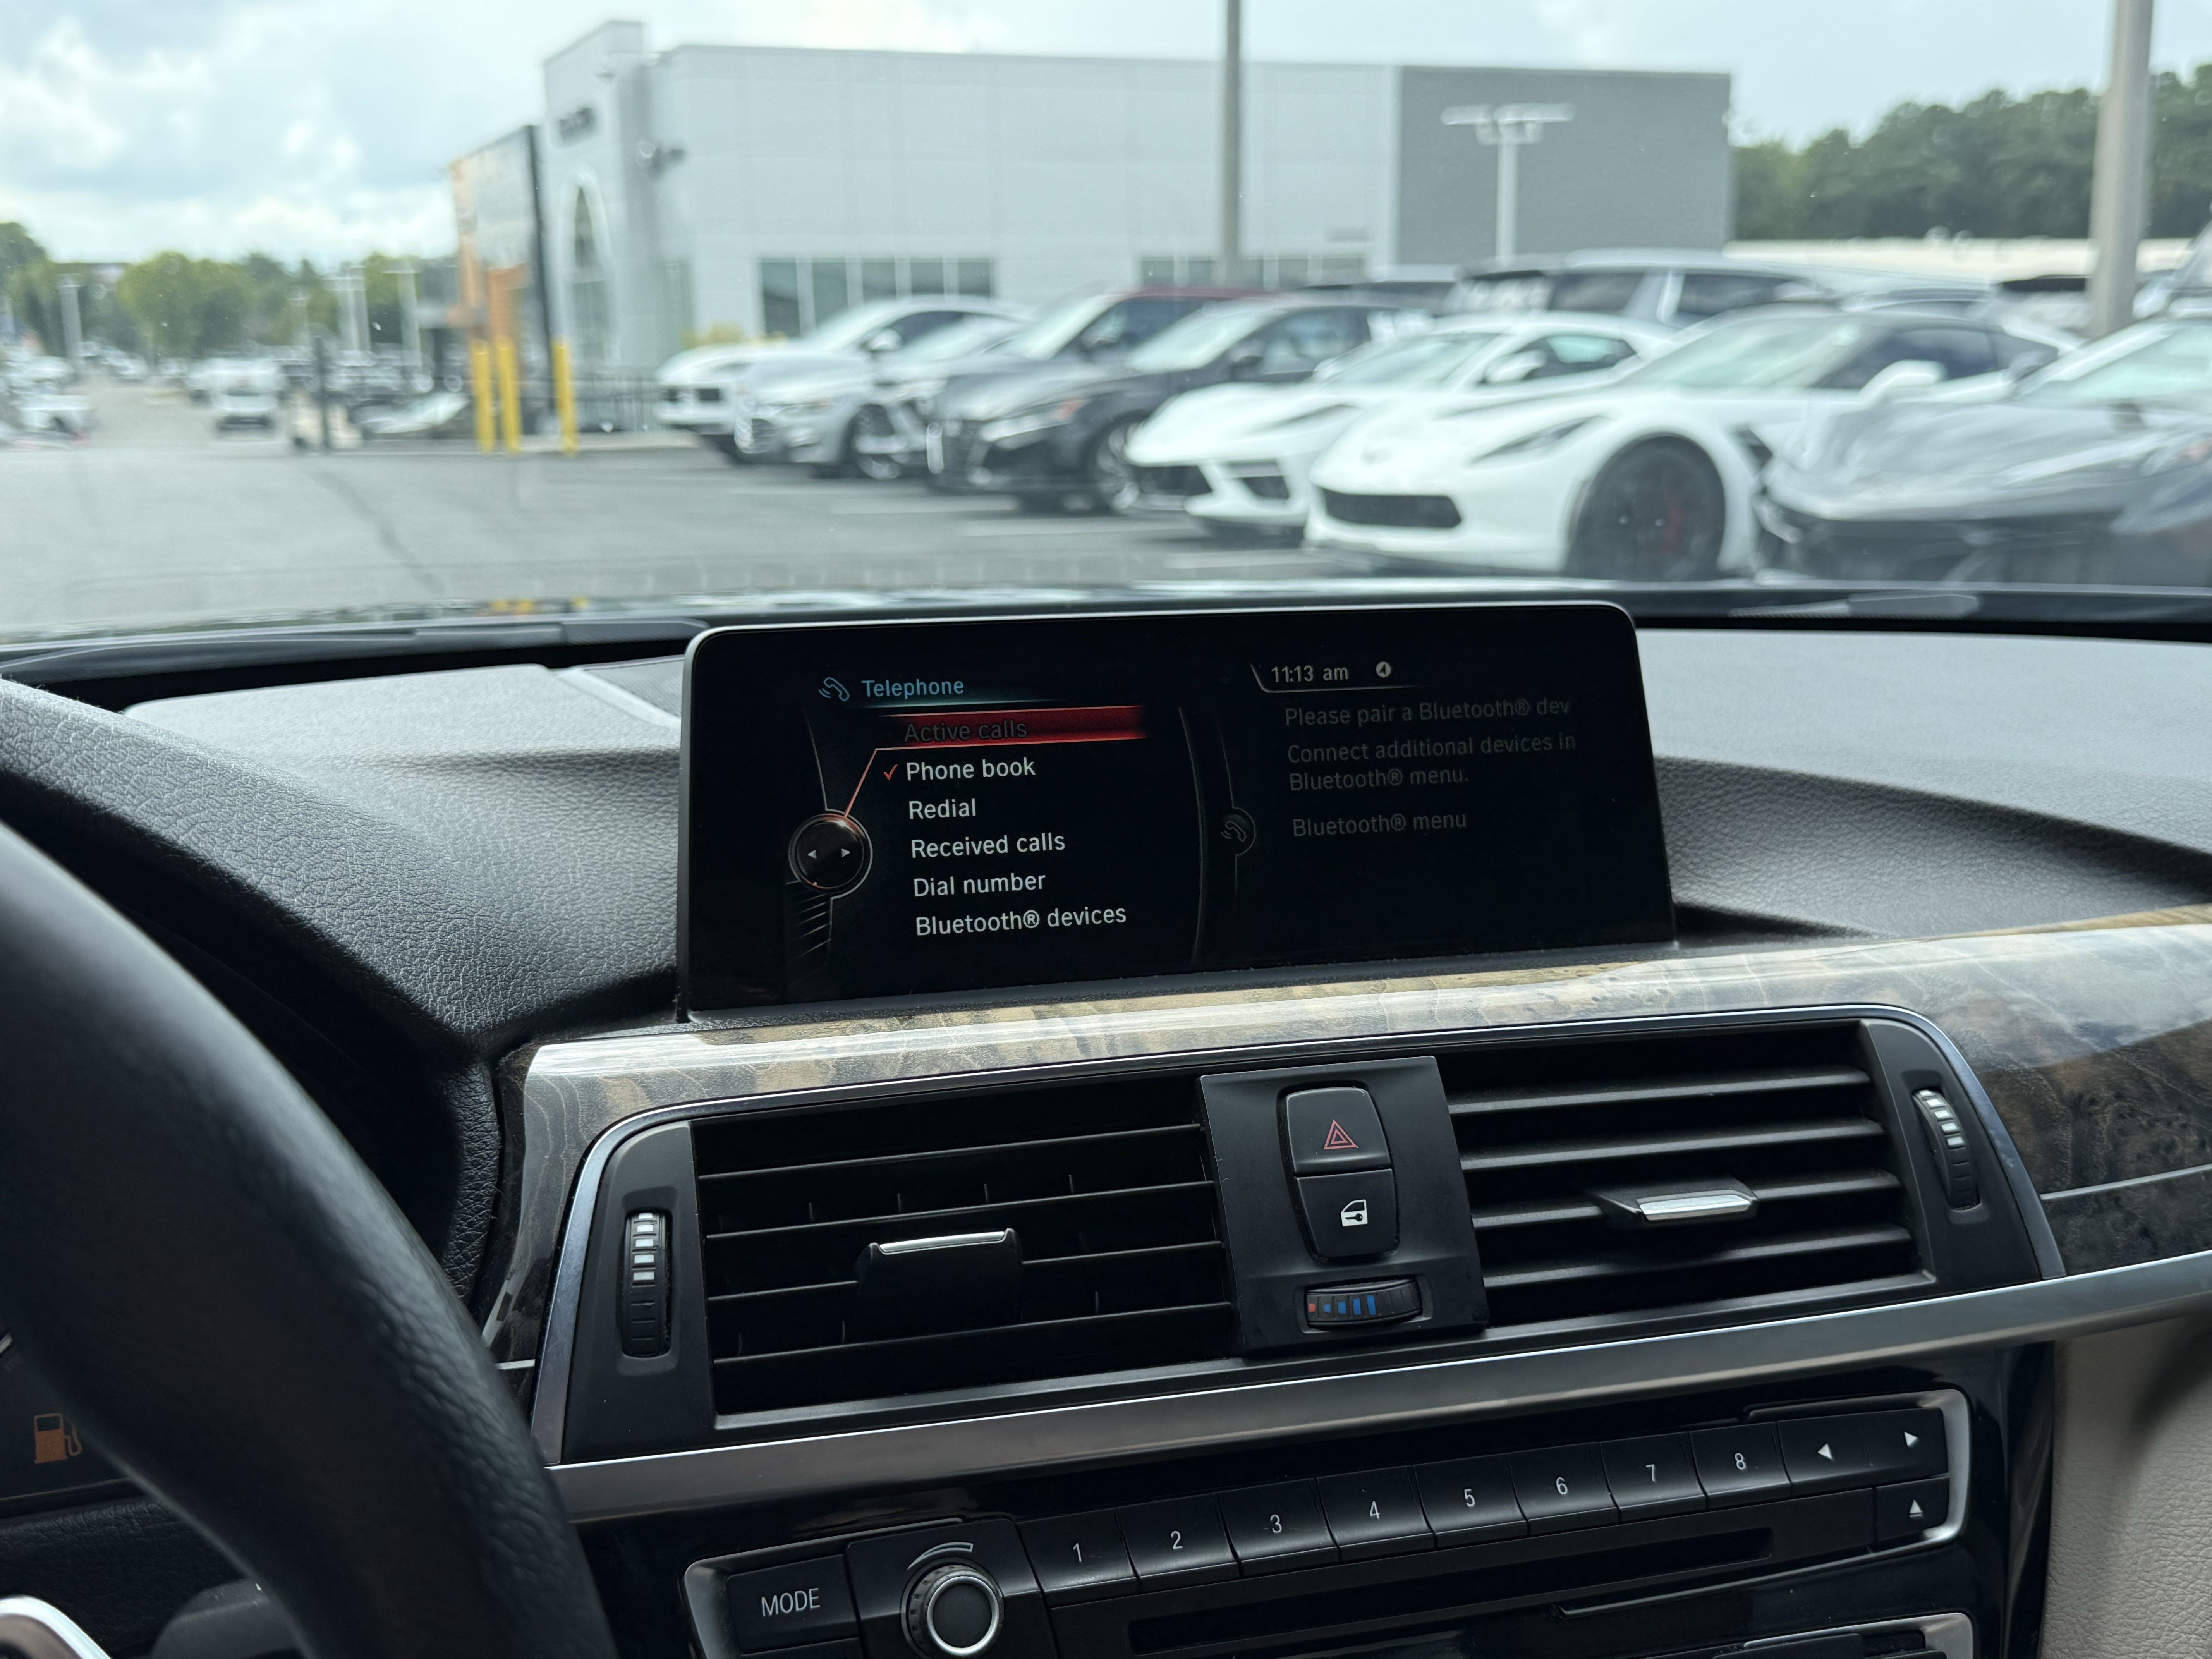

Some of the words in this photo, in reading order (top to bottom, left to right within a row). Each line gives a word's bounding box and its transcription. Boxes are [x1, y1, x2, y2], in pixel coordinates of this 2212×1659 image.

[1271, 665, 1314, 683] 11:13
[1322, 667, 1349, 681] am
[861, 678, 964, 700] Telephone
[1285, 708, 1350, 726] Please
[1357, 704, 1395, 728] pair
[1401, 706, 1412, 722] a
[1419, 697, 1531, 720] Bluetooth®
[1536, 697, 1570, 715] dev
[905, 721, 970, 742] Active
[977, 720, 1028, 740] calls
[1287, 743, 1369, 763] Connect
[1375, 736, 1473, 759] additional
[1480, 734, 1553, 754] devices
[1558, 732, 1576, 750] in
[906, 761, 975, 781] Phone
[982, 757, 1036, 778] book
[1289, 768, 1403, 792] Bluetooth®
[1410, 769, 1469, 785] menu.
[908, 797, 976, 820] Redial
[1292, 813, 1407, 837] Bluetooth®
[1413, 813, 1467, 830] menu
[911, 834, 1008, 859] Received
[1016, 832, 1066, 853] calls
[914, 876, 955, 897] Dial
[963, 872, 1046, 894] number
[915, 909, 1040, 936] Bluetooth®
[1047, 906, 1127, 927] devices
[1734, 1452, 1747, 1471] 8
[1645, 1463, 1656, 1483] 7
[1556, 1477, 1569, 1496] 6
[1464, 1488, 1476, 1508] 5
[1369, 1501, 1380, 1520] 4
[1269, 1514, 1283, 1534] 3
[1170, 1530, 1183, 1550] 2
[1073, 1543, 1082, 1563] 1
[761, 1587, 821, 1617] MODE
